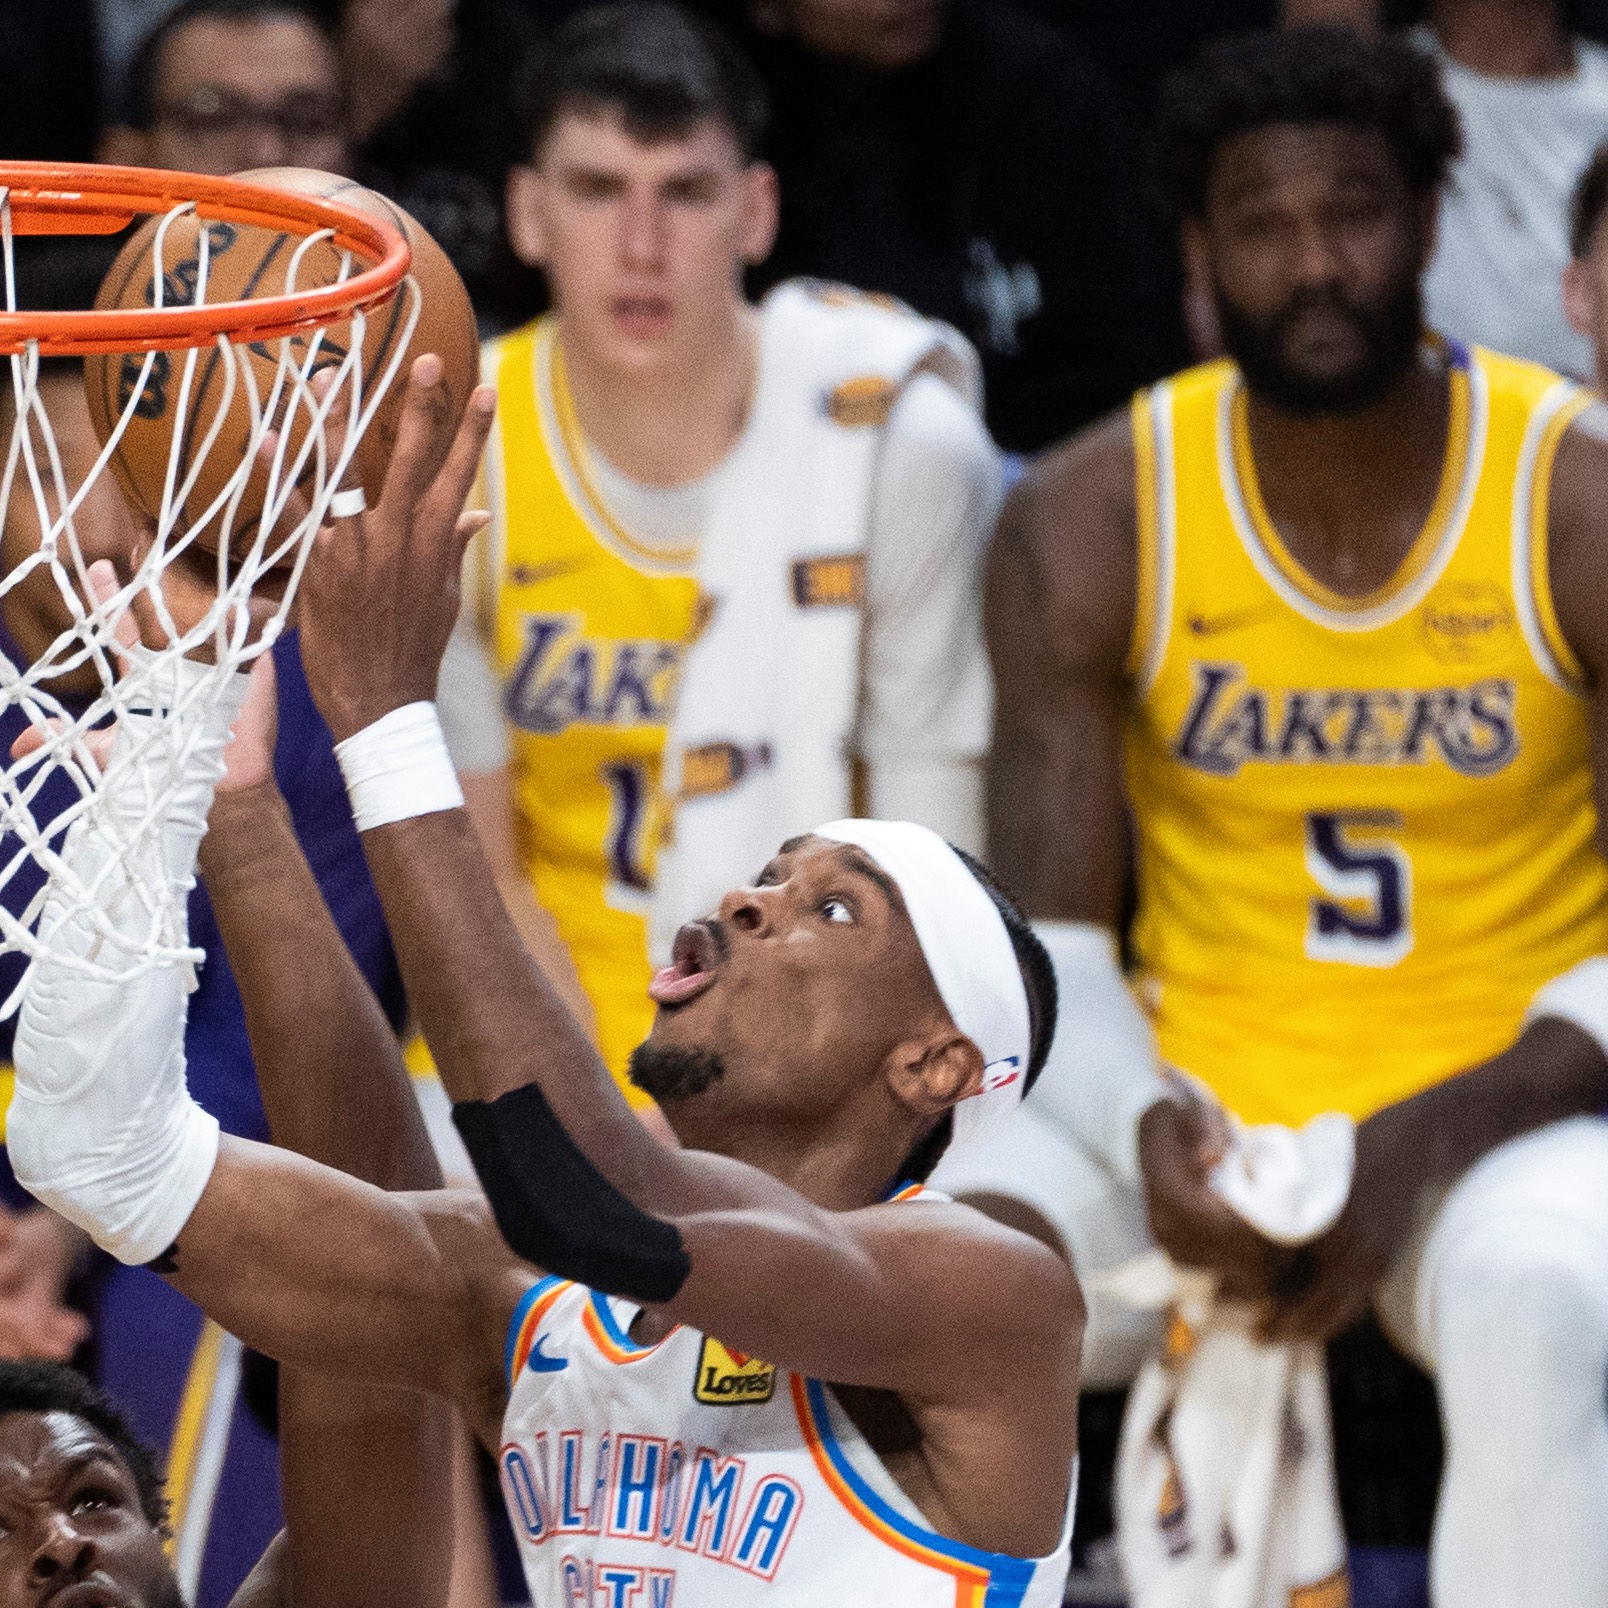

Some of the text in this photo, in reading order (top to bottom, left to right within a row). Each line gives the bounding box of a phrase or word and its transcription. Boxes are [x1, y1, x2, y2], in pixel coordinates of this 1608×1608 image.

[504, 612, 684, 737] LAK
[1173, 658, 1522, 778] LAKERS
[1306, 809, 1412, 966] 5
